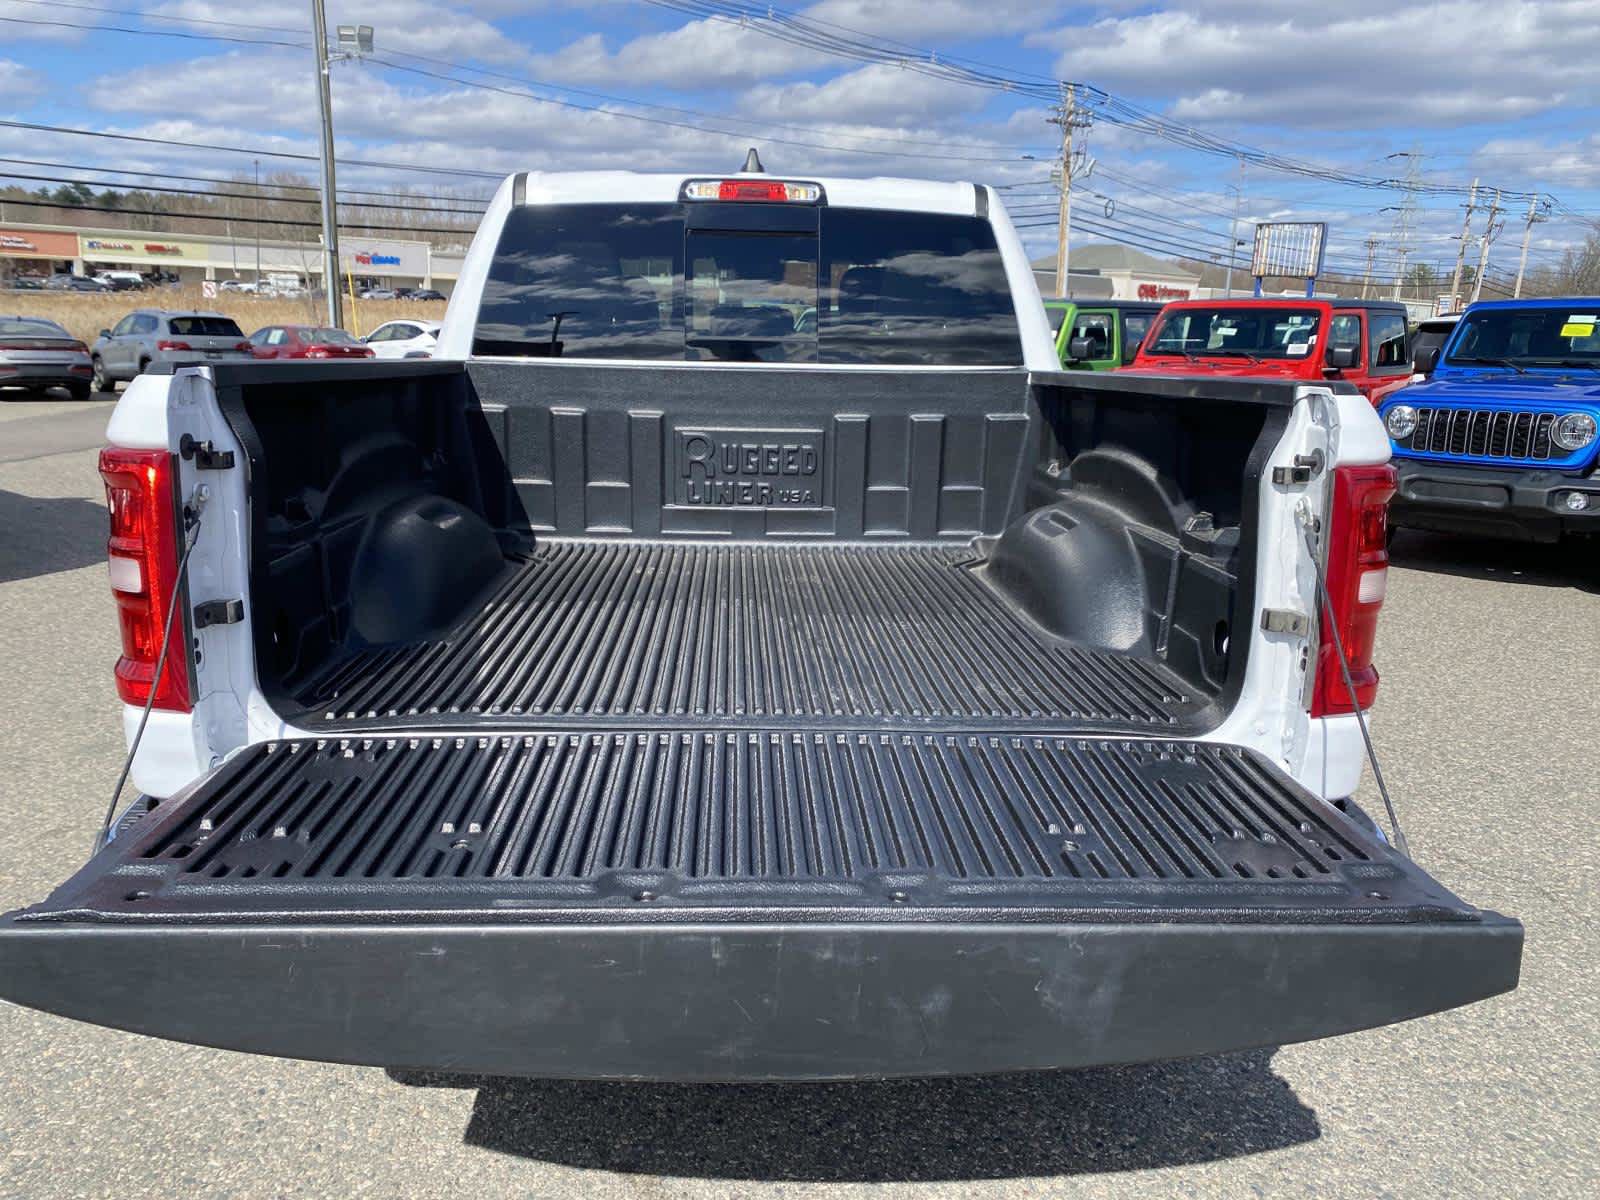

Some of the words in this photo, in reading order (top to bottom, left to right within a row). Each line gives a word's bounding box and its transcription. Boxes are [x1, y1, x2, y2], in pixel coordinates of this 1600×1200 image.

[681, 431, 818, 479] RUGGED
[687, 480, 773, 505] LINER
[779, 489, 816, 504] USA
